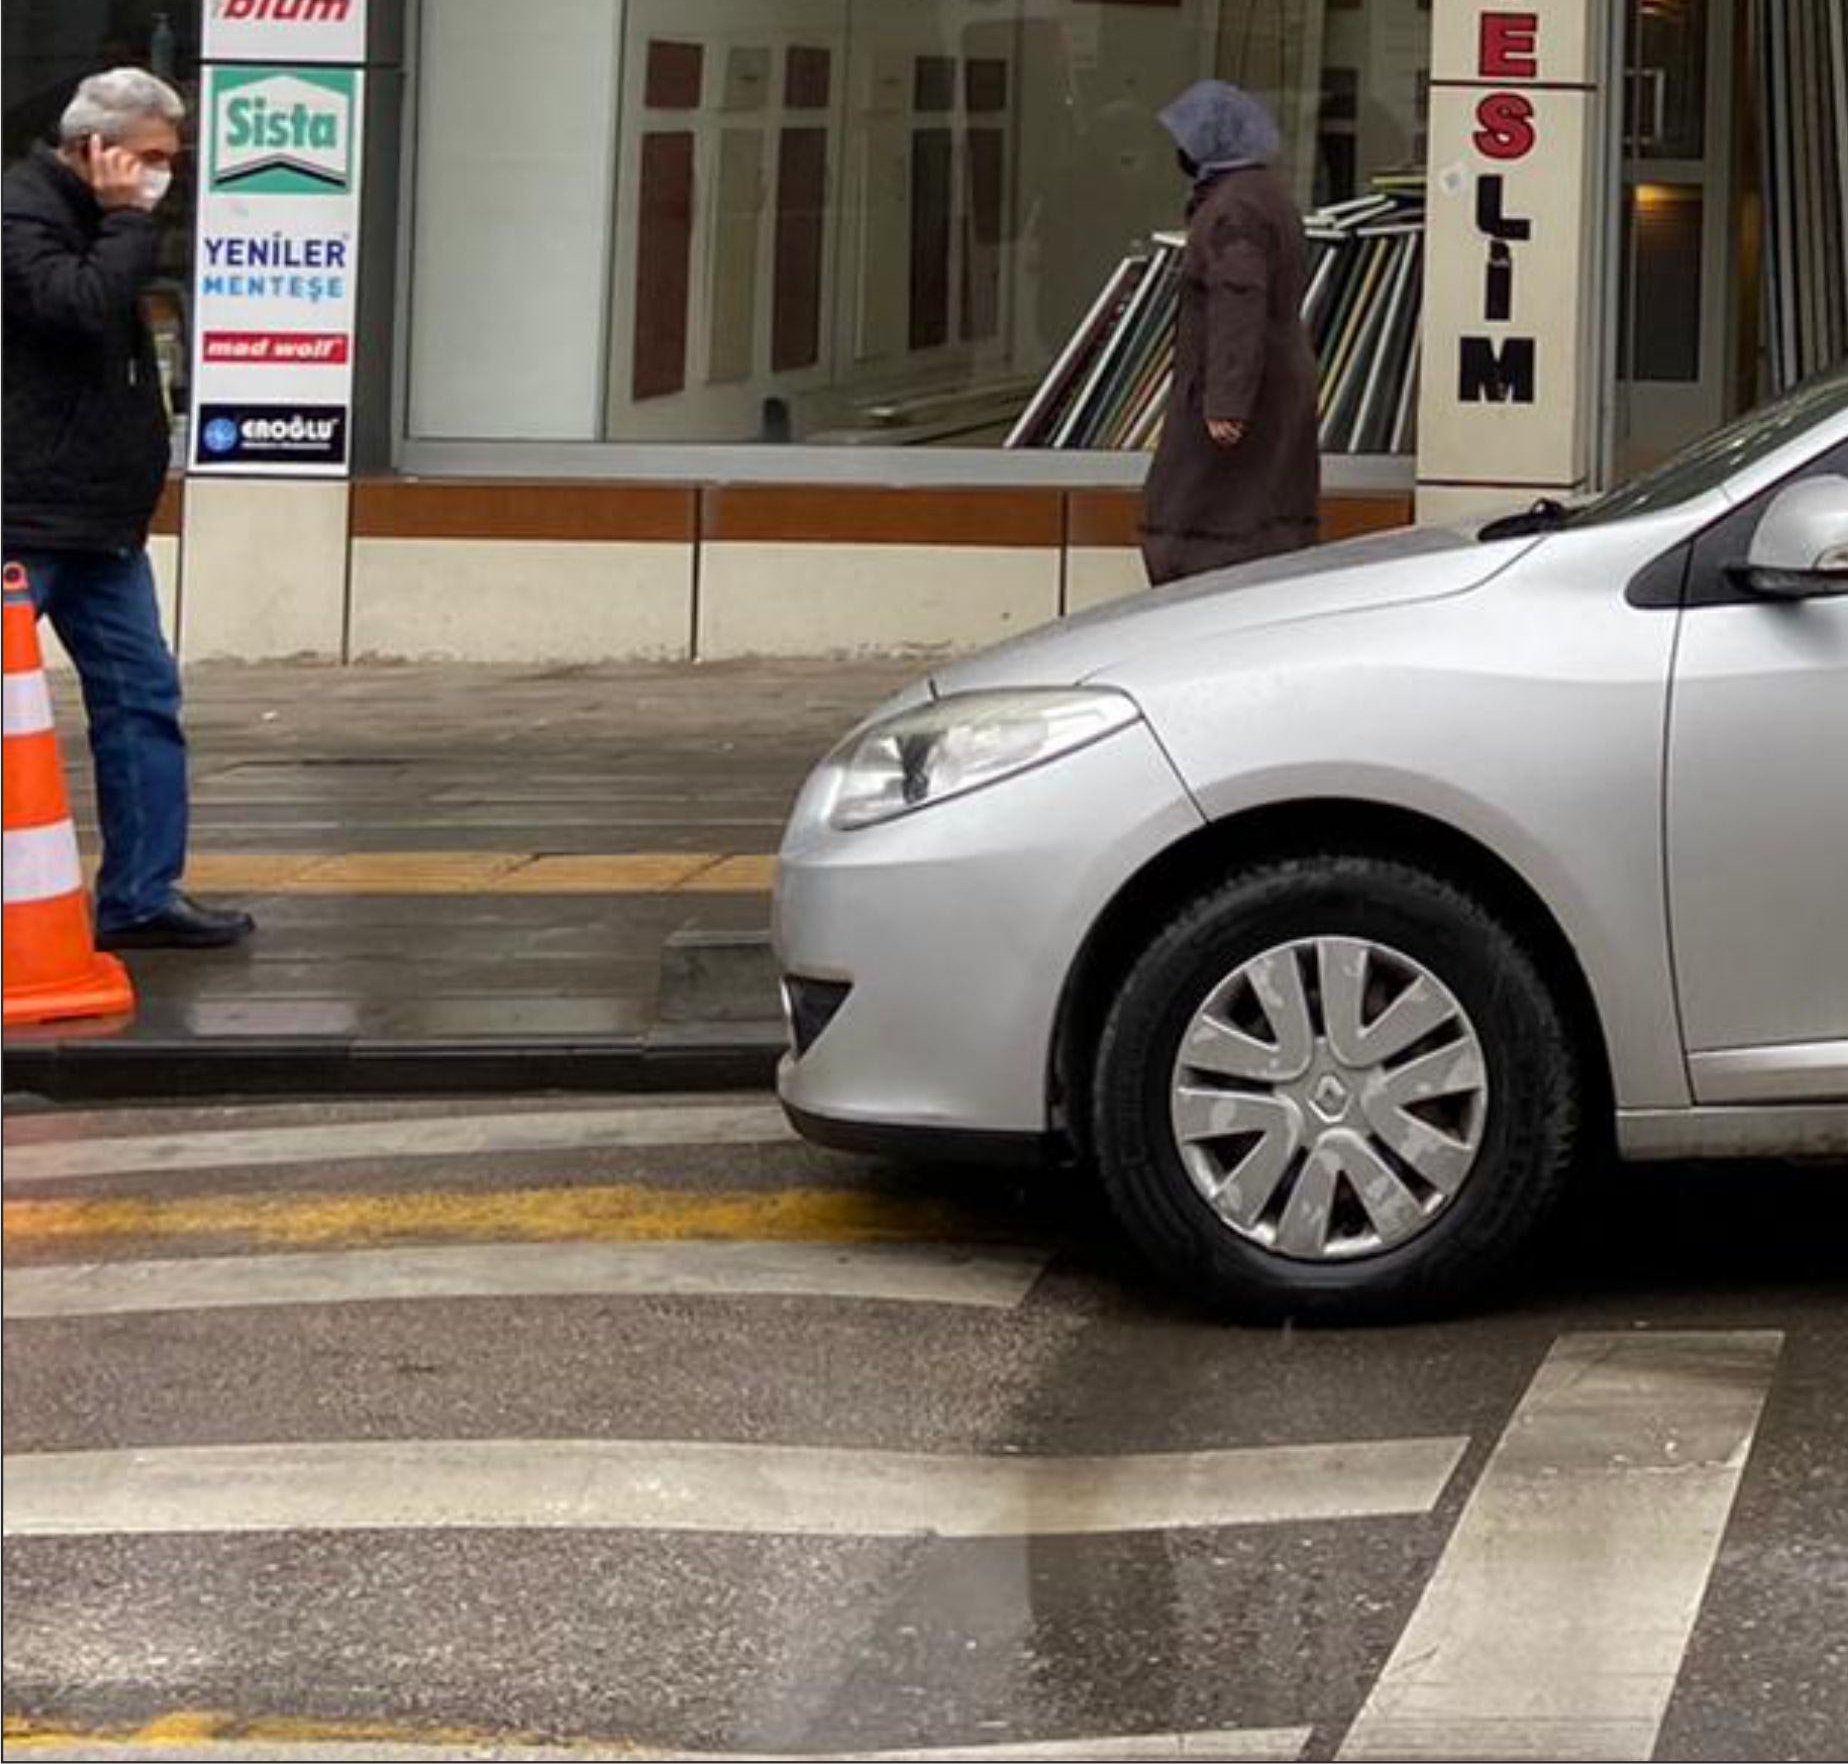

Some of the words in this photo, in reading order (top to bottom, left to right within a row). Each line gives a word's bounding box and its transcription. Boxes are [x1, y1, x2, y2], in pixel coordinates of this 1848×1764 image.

[226, 97, 338, 149] Sista
[205, 233, 346, 268] YENİLER
[203, 274, 345, 302] MENTEŞE
